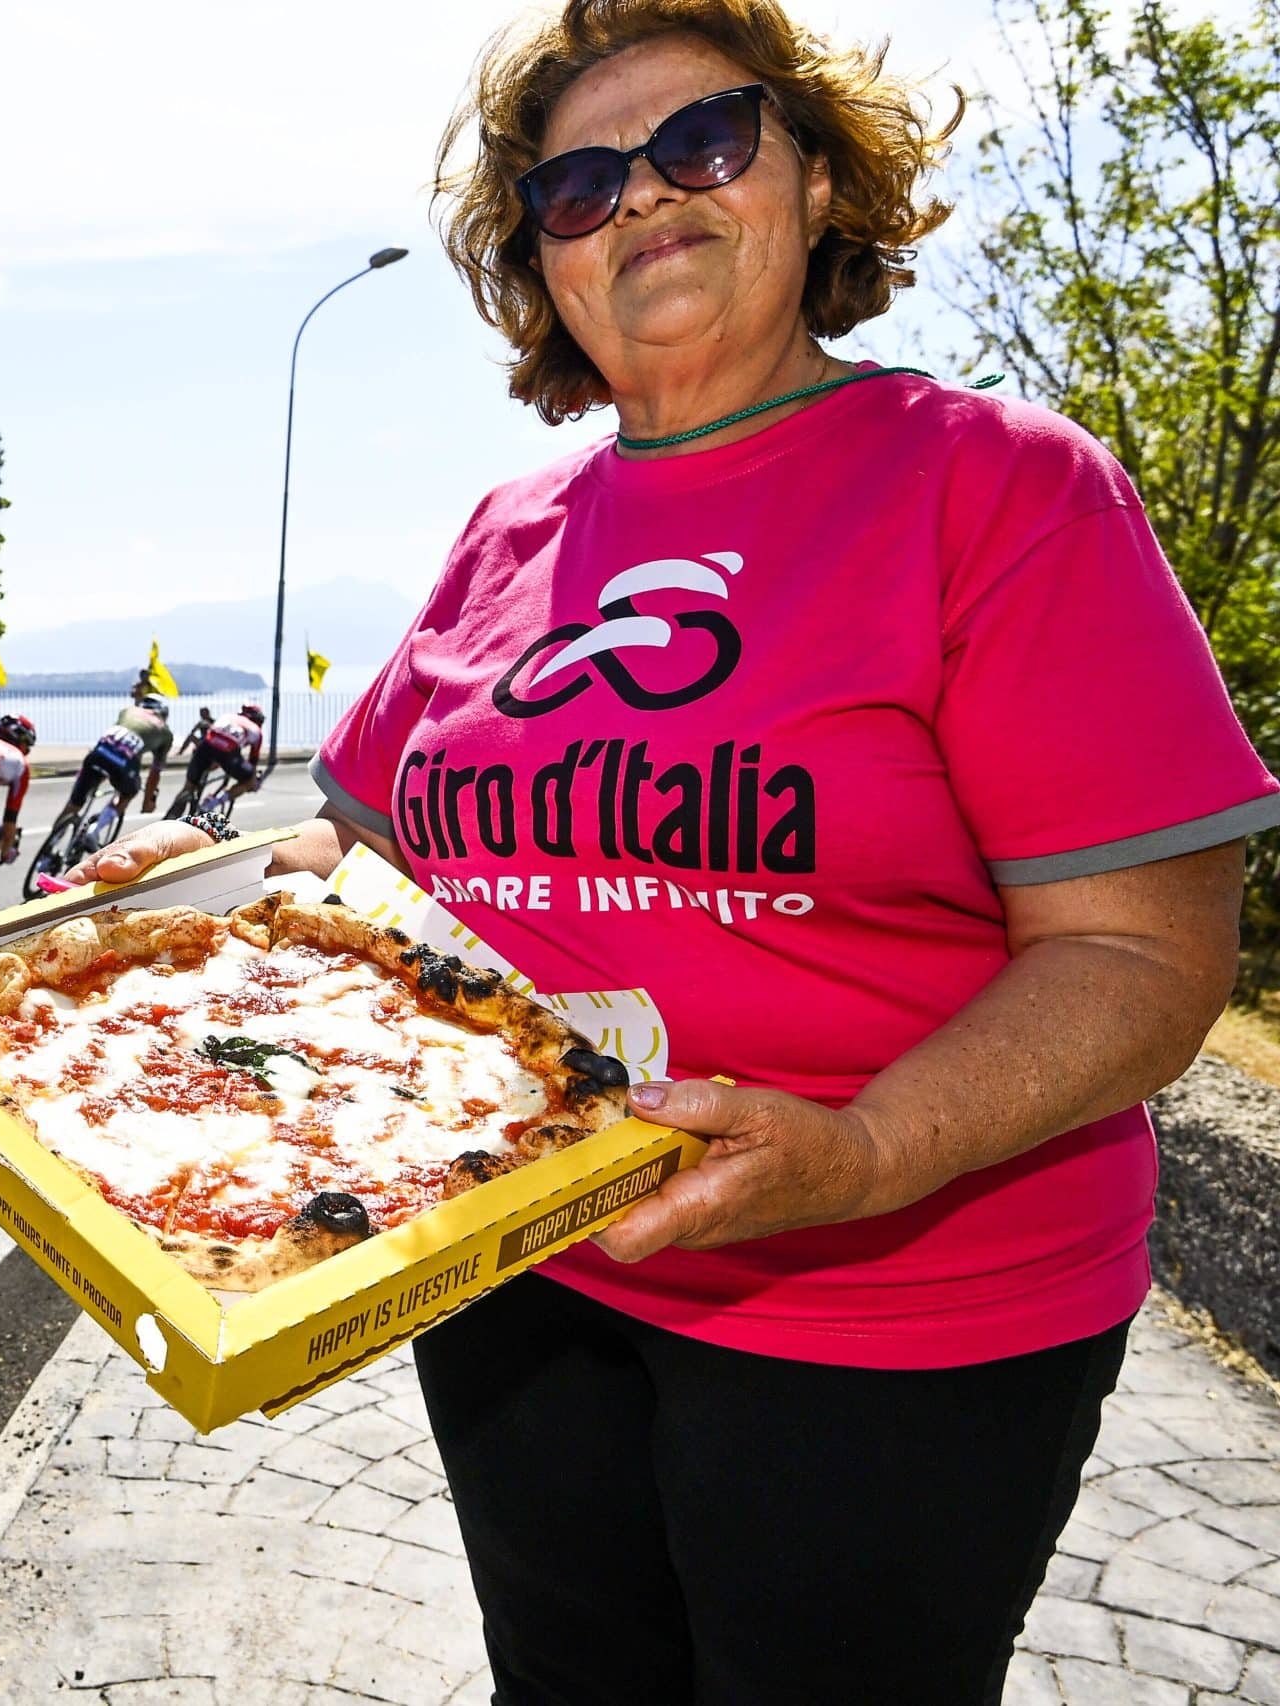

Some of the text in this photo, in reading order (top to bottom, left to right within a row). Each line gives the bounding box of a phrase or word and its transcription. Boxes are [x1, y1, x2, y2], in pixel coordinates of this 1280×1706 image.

[397, 738, 816, 875] Giro d'Italia
[521, 1160, 663, 1255] HAPPY IS FREEDOM
[13, 1210, 41, 1249] HOURS
[43, 1238, 71, 1279] MONTE
[72, 1266, 82, 1289] DI
[83, 1278, 122, 1329] PROCIDA
[307, 1252, 482, 1365] HAPPY IS LIFESTYLE
